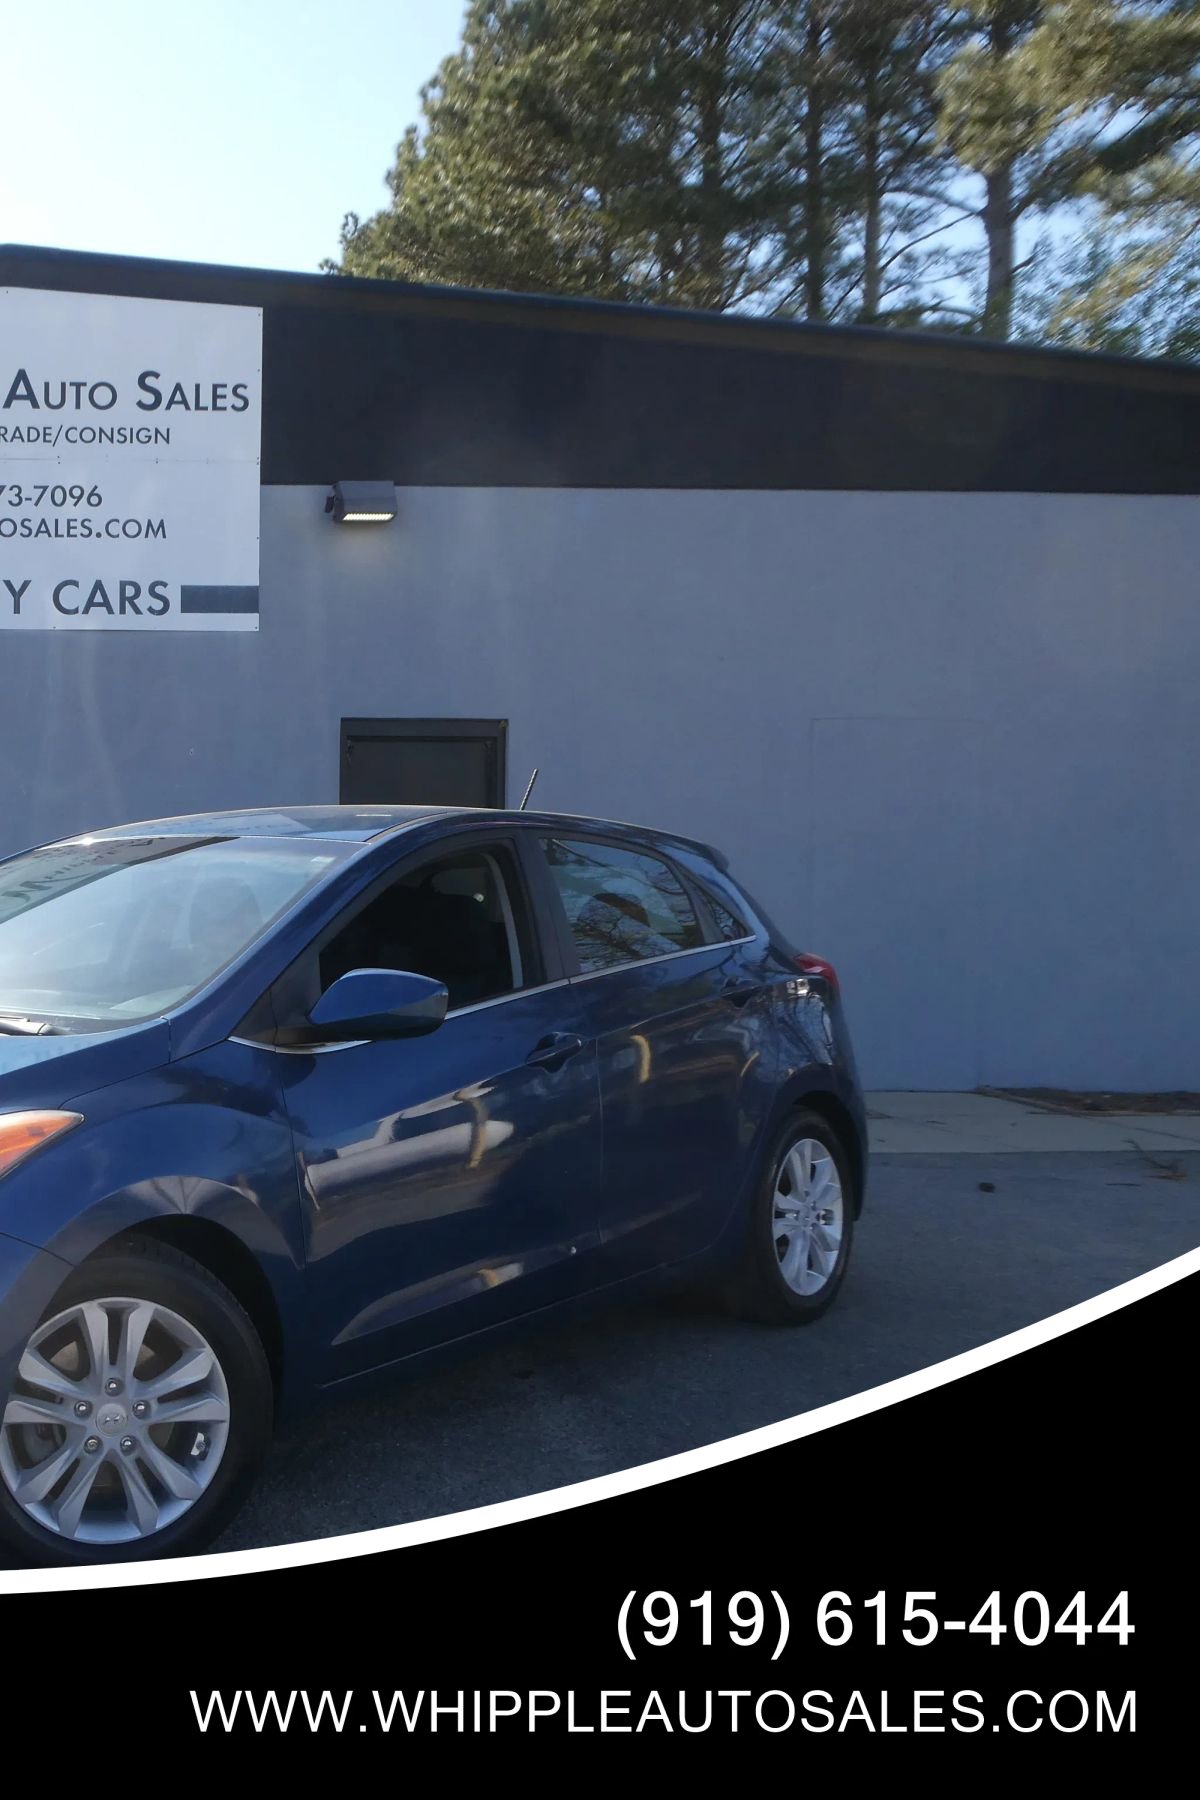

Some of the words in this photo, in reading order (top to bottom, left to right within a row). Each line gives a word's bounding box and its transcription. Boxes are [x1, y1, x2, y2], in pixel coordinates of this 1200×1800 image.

[3, 369, 118, 411] AUTO
[136, 371, 249, 412] SALES
[52, 580, 171, 617] CARS
